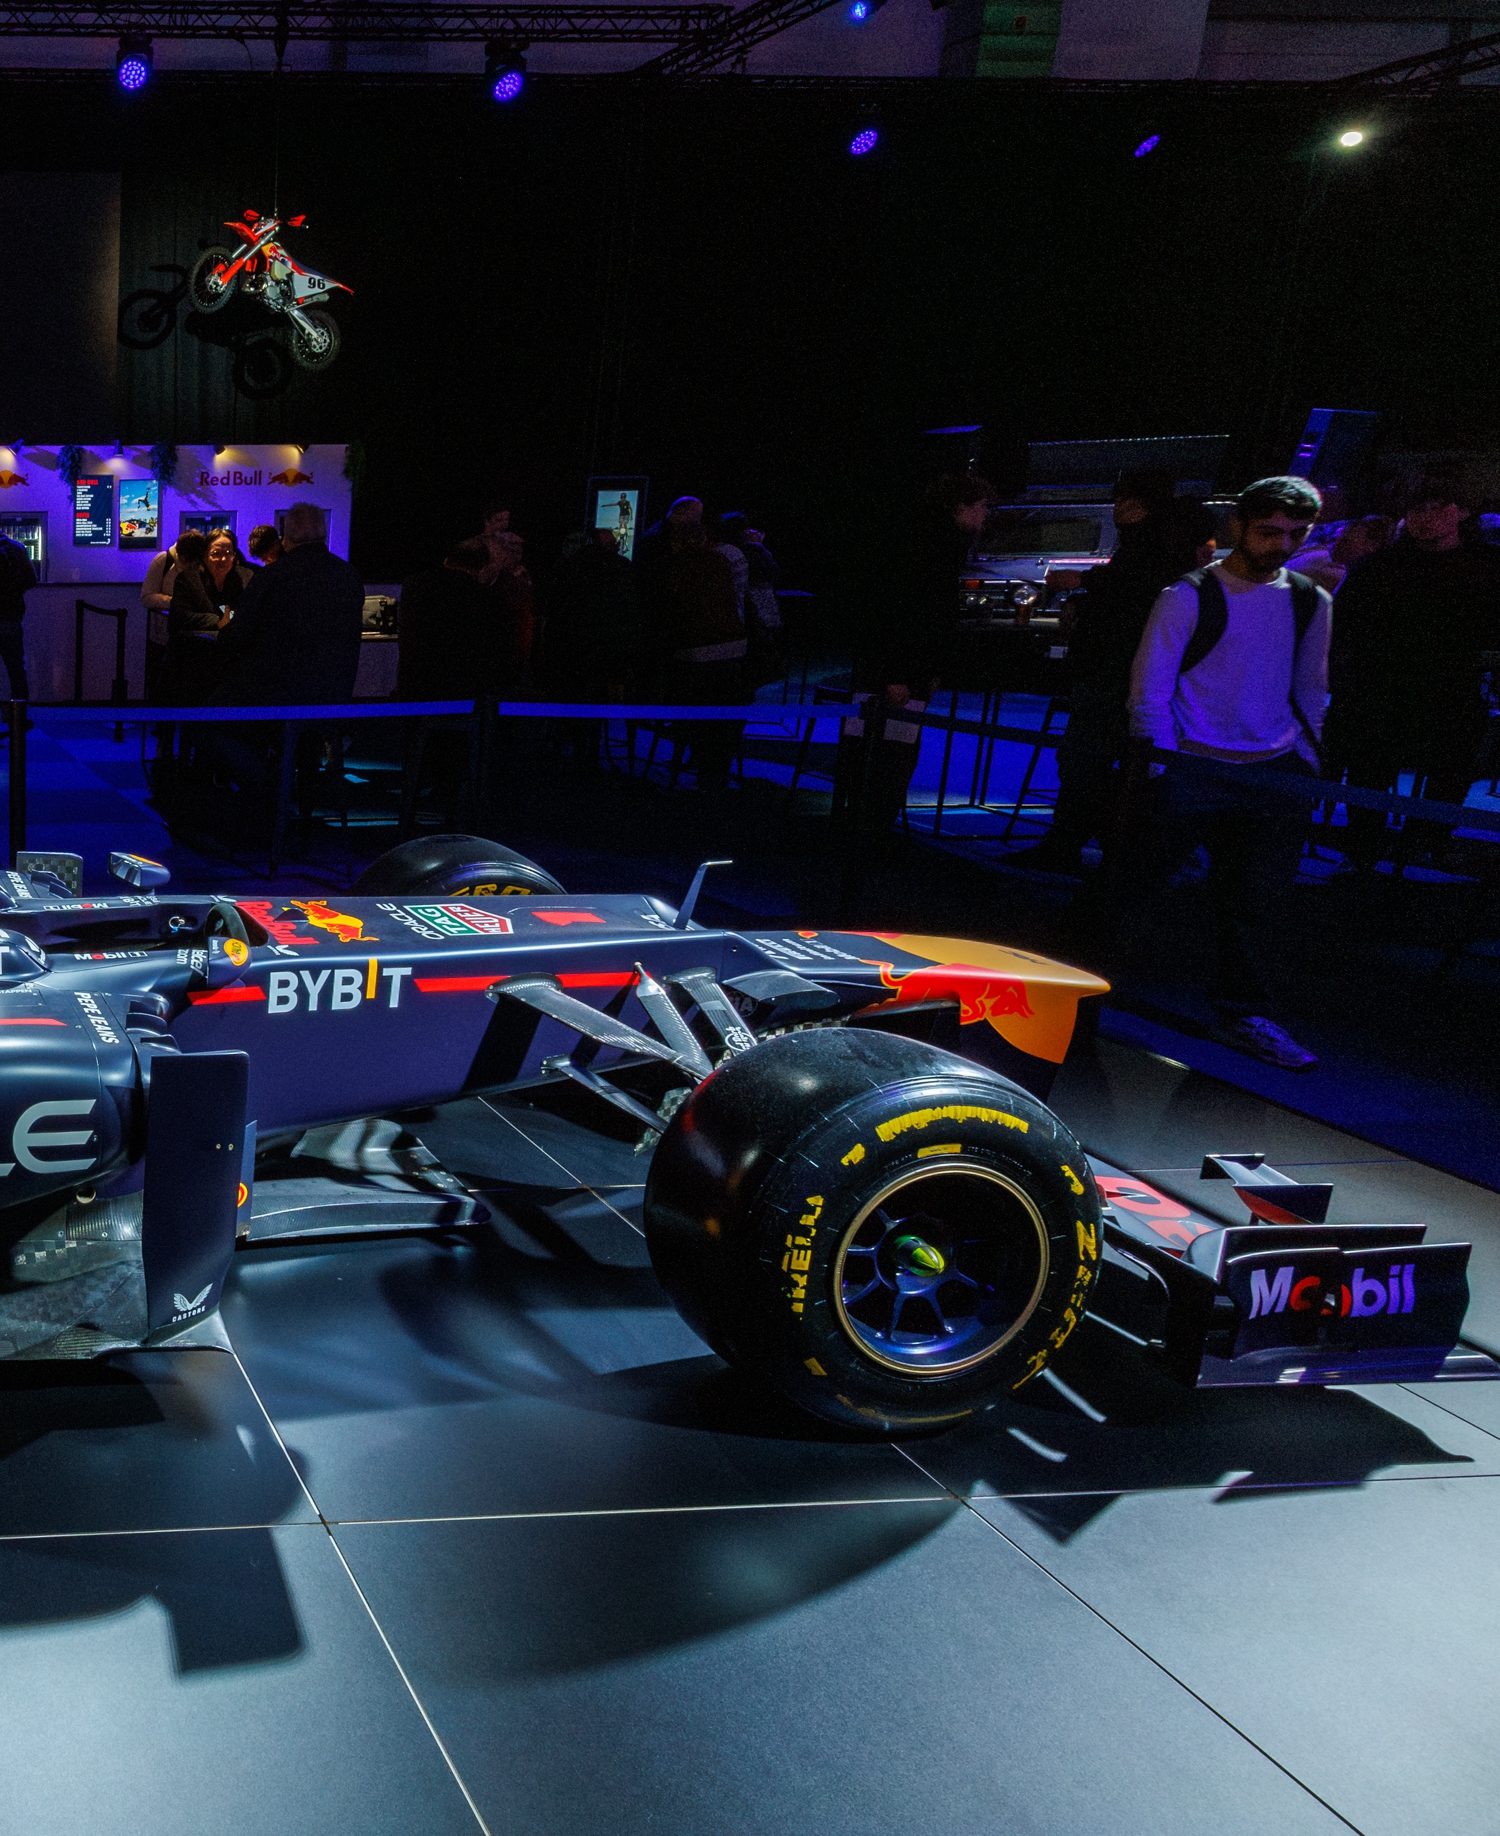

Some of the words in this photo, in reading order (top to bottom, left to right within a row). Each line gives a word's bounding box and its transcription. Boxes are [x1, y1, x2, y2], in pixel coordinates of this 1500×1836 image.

[307, 276, 326, 290] 96
[199, 470, 231, 486] Red
[232, 470, 262, 486] Bull
[376, 902, 445, 940] ORACLE
[417, 907, 469, 934] TAG
[447, 905, 503, 935] HEUER
[74, 951, 127, 961] Mobil
[268, 958, 412, 1014] BYBIT
[74, 991, 102, 1017] PEPE
[87, 1014, 120, 1044] JEANS
[1248, 1263, 1416, 1320] Mobil
[172, 1305, 206, 1323] CASTORE
